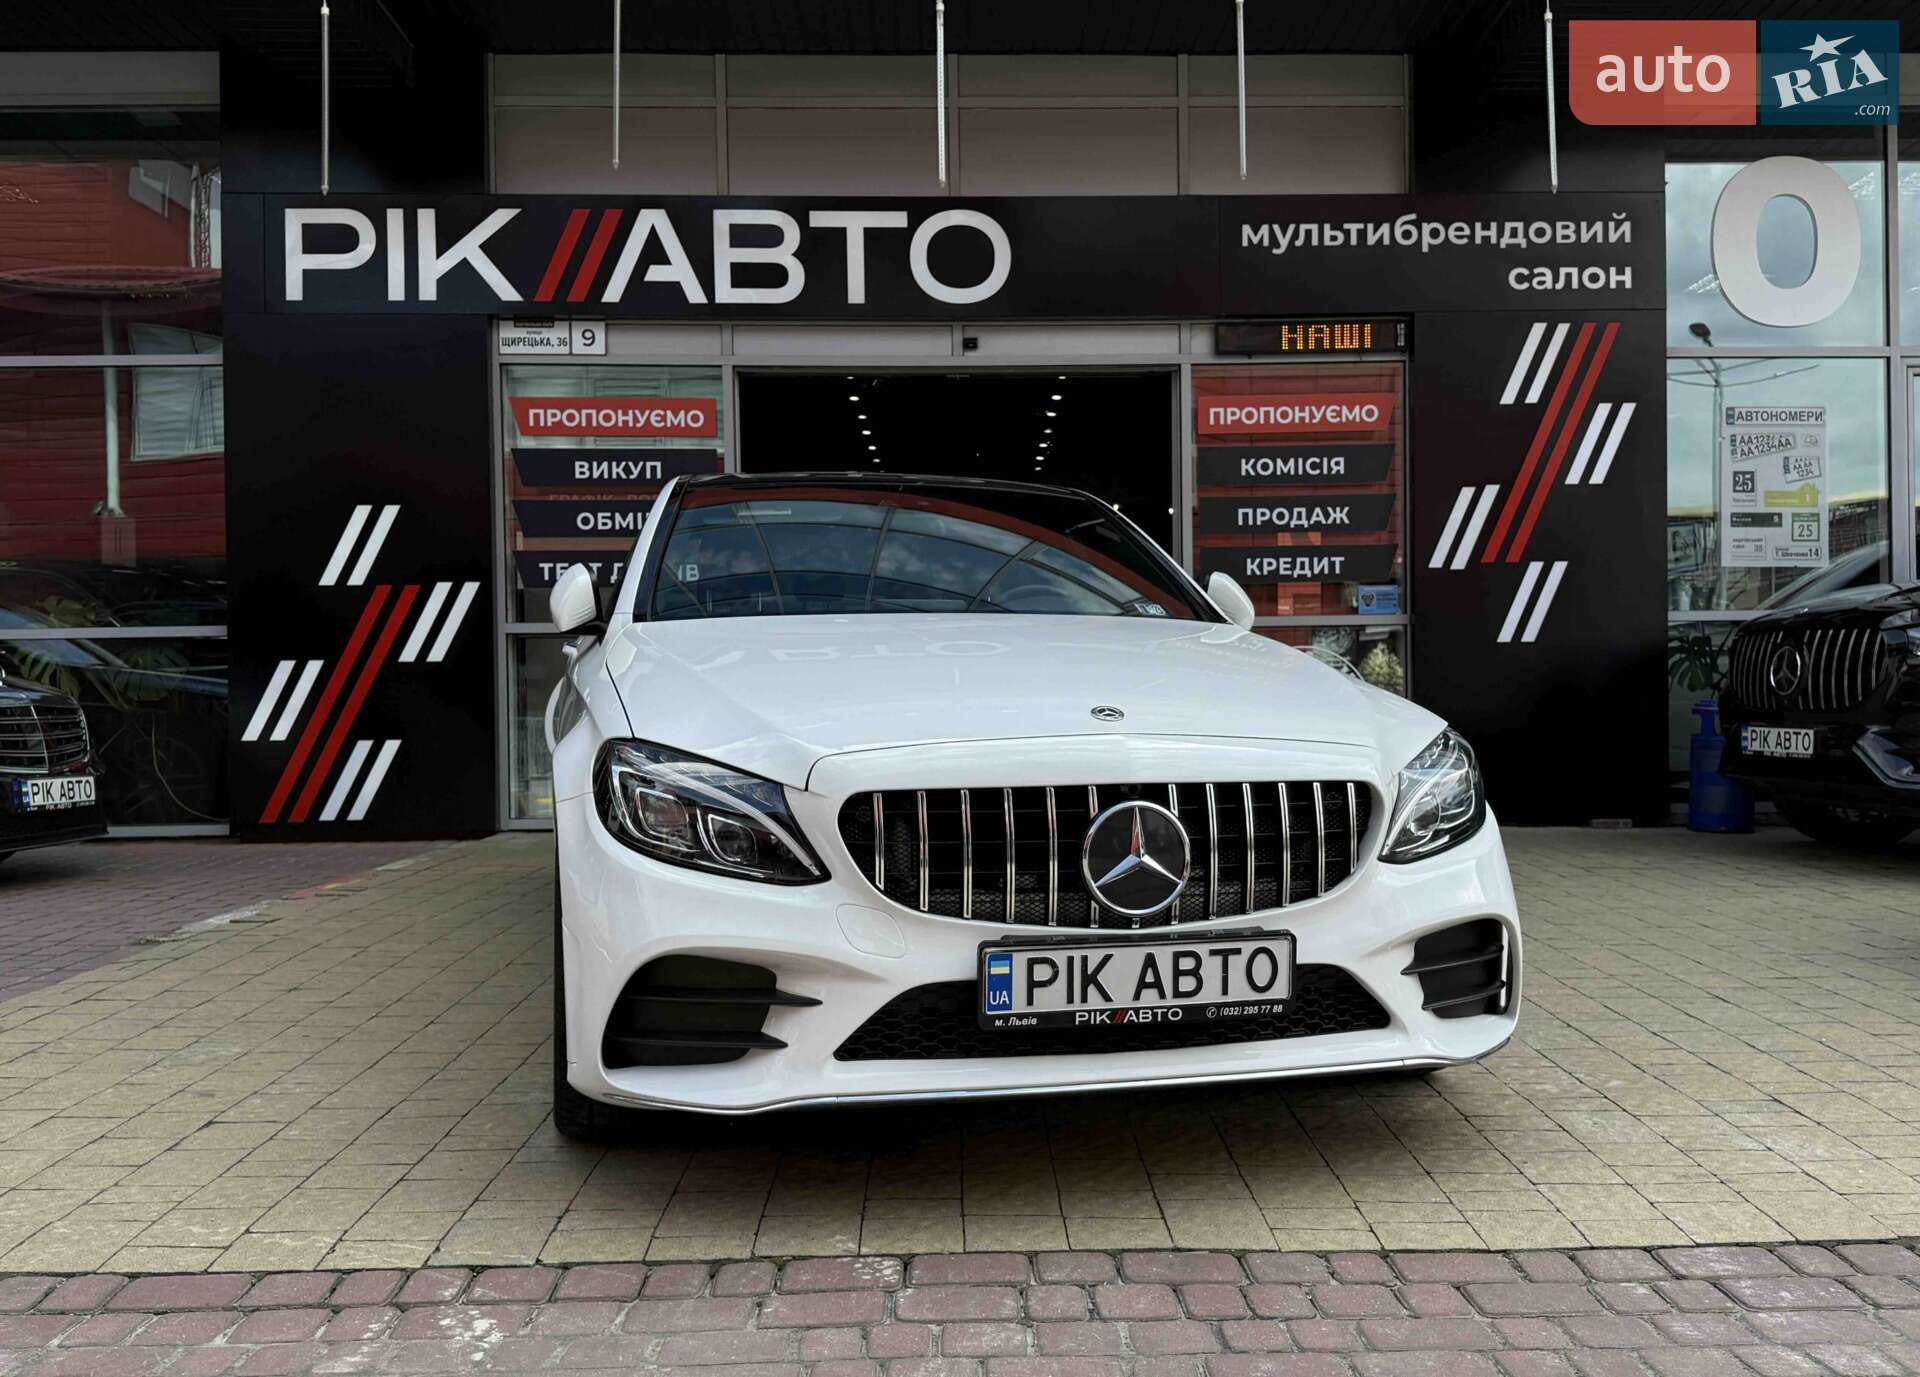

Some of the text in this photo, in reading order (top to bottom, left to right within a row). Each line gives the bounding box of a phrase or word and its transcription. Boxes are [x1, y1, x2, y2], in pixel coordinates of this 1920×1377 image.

[1241, 213, 1632, 254] мультибрендовий
[1508, 266, 1632, 290] салон
[502, 337, 568, 348] ЩИРЕЦЬКА, 36
[582, 328, 596, 347] 9
[1282, 324, 1371, 350] НАШІ
[528, 408, 705, 428] ПРОПОНУЄМО
[1209, 404, 1379, 425] ПРОПОНУЄМО
[1736, 410, 1823, 422] АВТОНОМЕРИ
[574, 461, 662, 479] ВИКУП
[1240, 457, 1345, 476] КОМІСІЯ
[1735, 473, 1752, 492] 25
[576, 512, 651, 531] ОБМІ
[1237, 506, 1350, 528] ПРОДАЖ
[1798, 524, 1813, 538] 25
[1246, 556, 1345, 578] КРЕДИТ
[1750, 729, 1811, 751] РІК АВТО
[30, 781, 55, 803] РІК
[59, 780, 92, 801] АВТО
[1027, 946, 1279, 1006] РІК АВТО
[990, 990, 1010, 1005] UA
[1220, 1004, 1283, 1016] (032) 295 77 88
[1008, 1016, 1038, 1026] Львів
